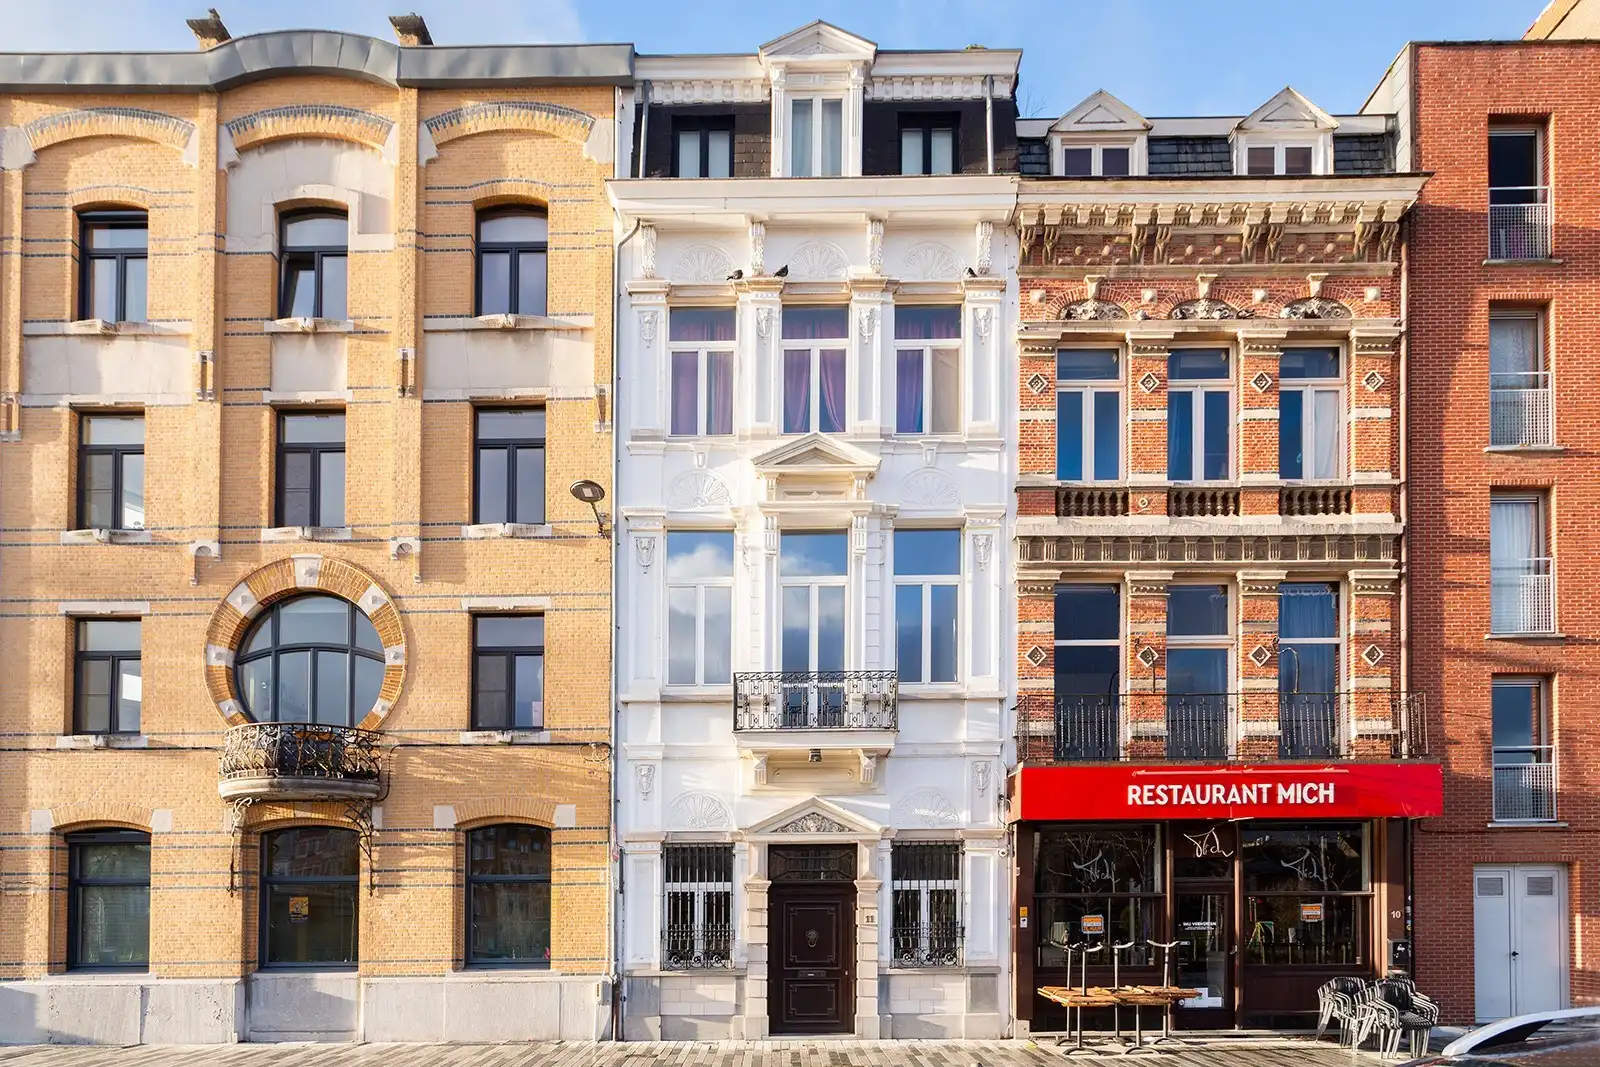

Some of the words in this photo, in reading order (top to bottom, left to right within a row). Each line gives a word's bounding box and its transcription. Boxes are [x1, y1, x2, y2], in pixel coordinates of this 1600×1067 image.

[1127, 784, 1272, 805] RESTAURANT
[1277, 782, 1335, 804] MICH
[865, 915, 875, 923] 11
[1391, 910, 1402, 919] 10
